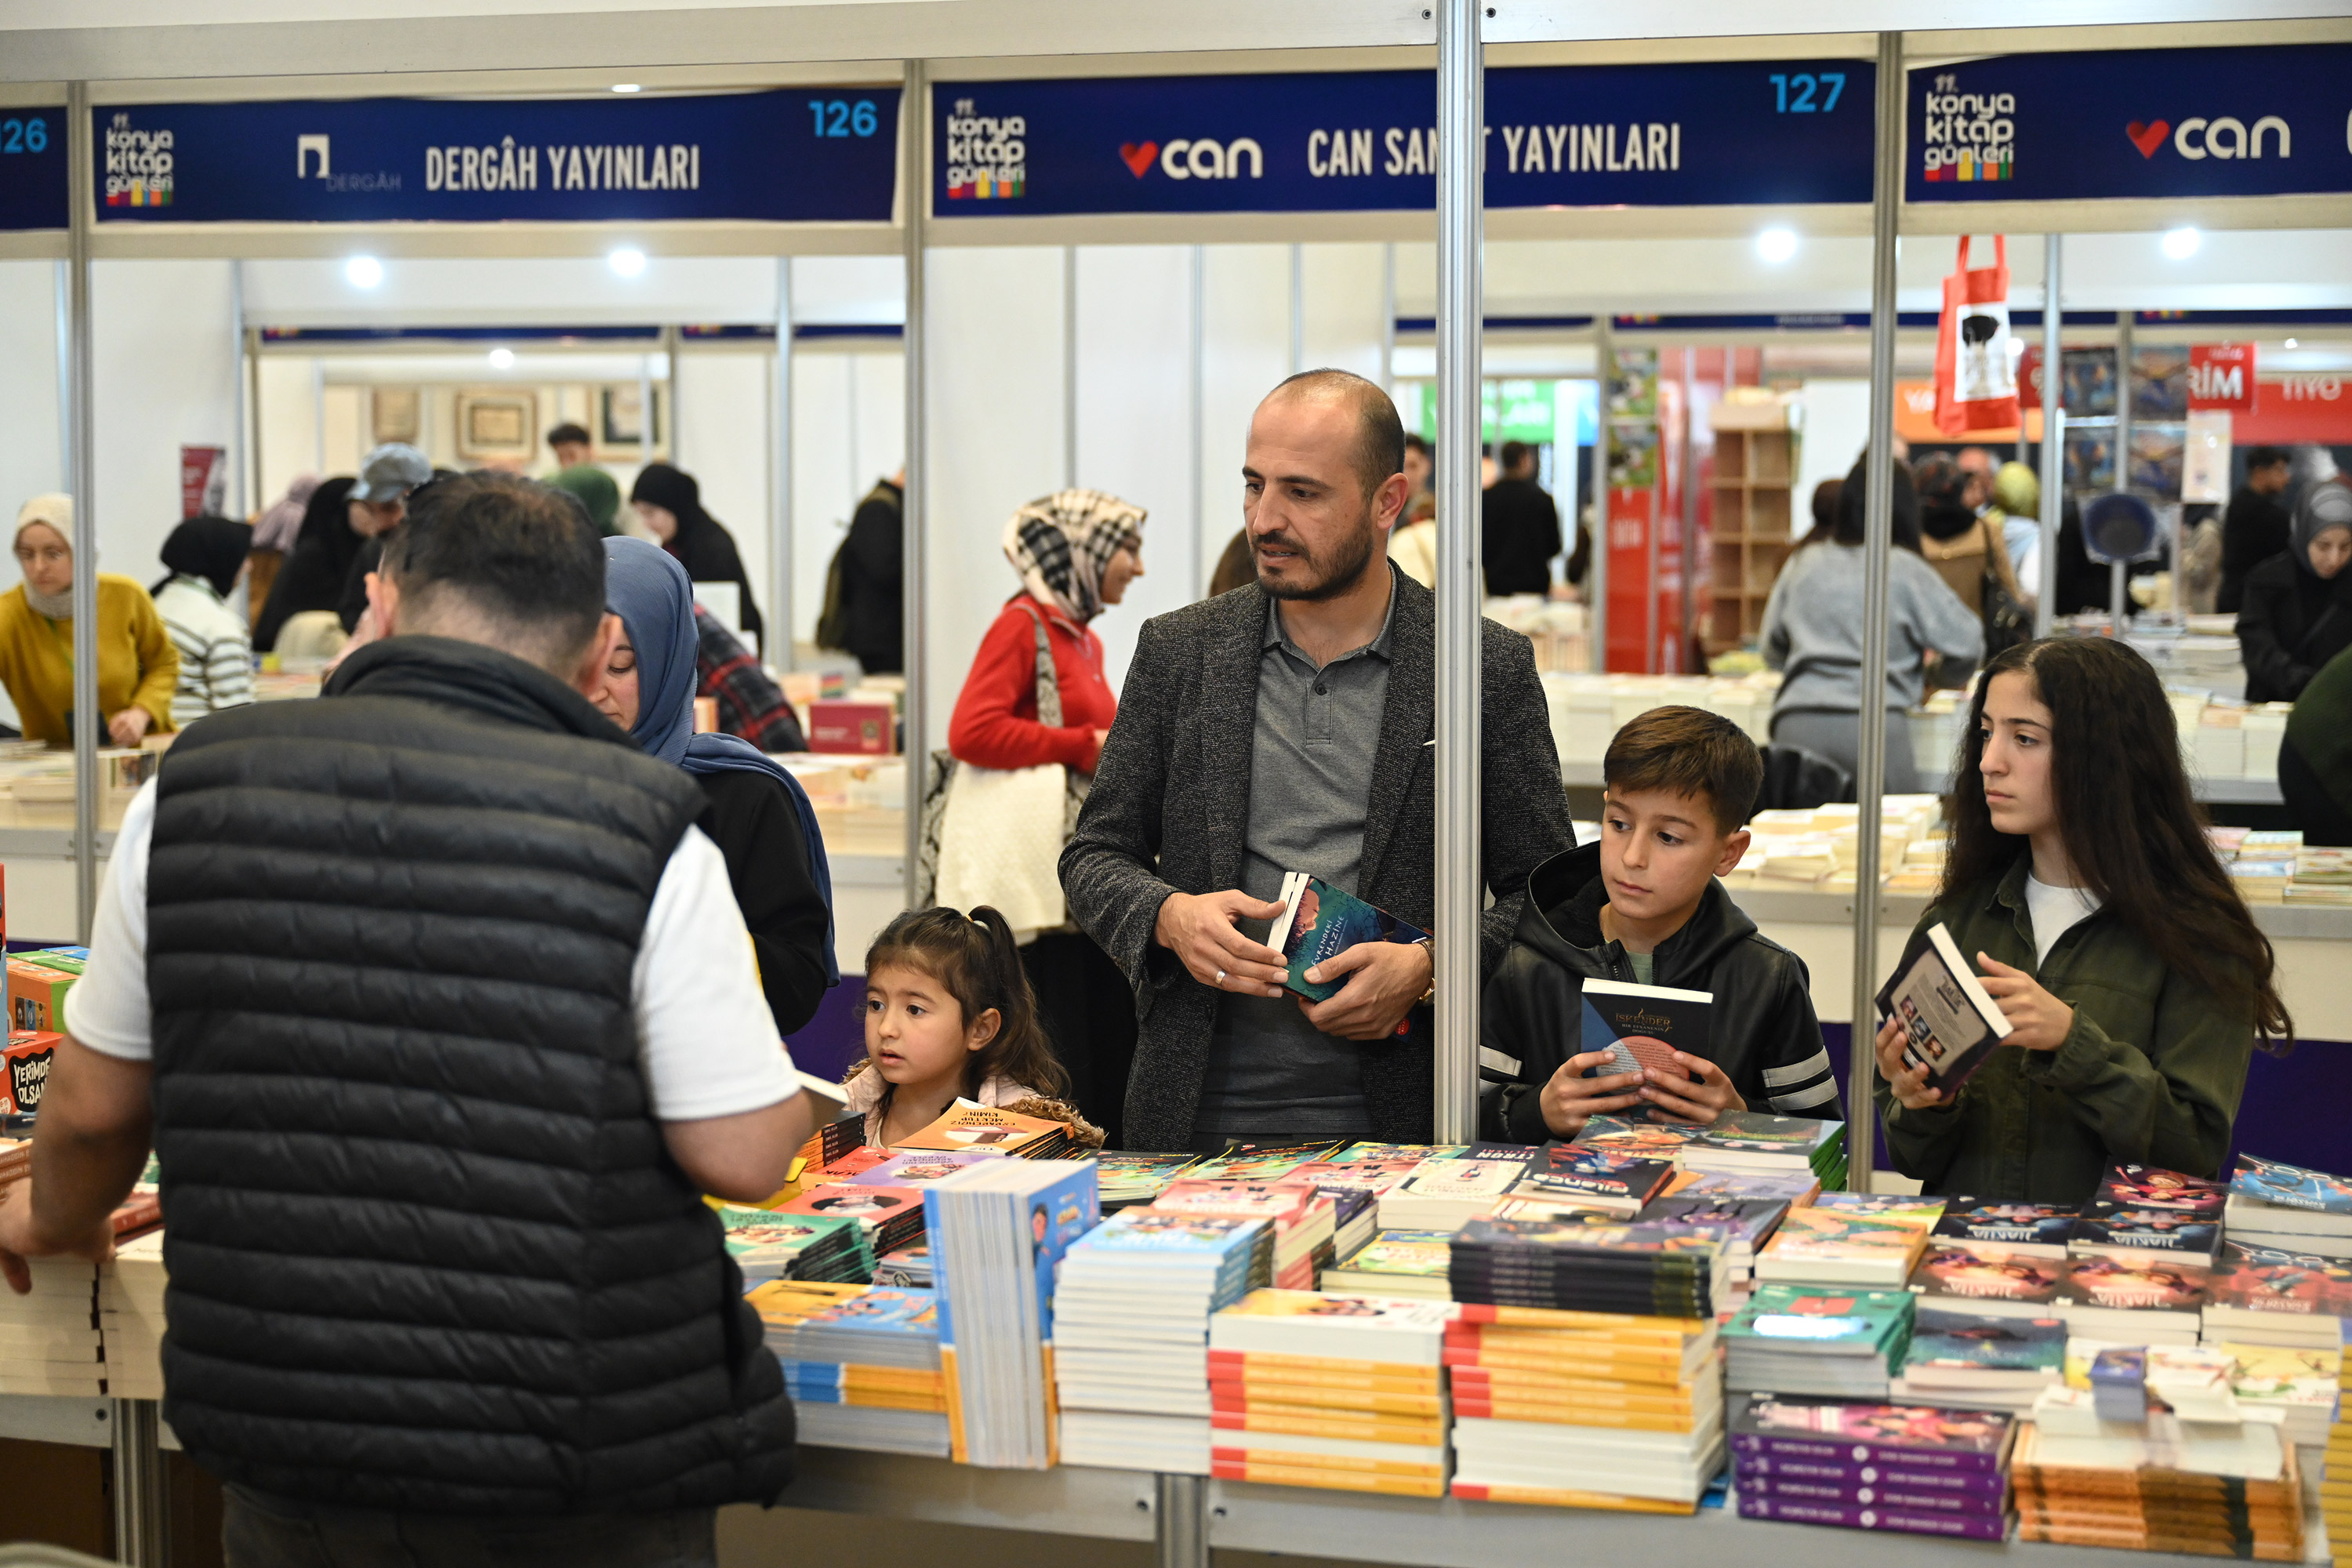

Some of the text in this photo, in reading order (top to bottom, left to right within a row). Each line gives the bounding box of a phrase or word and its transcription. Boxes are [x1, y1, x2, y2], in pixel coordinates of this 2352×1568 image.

[1769, 73, 1846, 113] 127
[1926, 91, 2015, 119] konya
[808, 100, 878, 137] 126
[947, 114, 1025, 140] konya
[1925, 114, 2014, 146] kitap
[0, 118, 47, 153] 26
[107, 127, 174, 151] konya
[947, 136, 1025, 164] kitap
[1308, 129, 1373, 177] CAN
[1502, 122, 1681, 173] YAYINLARI
[2174, 115, 2291, 160] can
[107, 147, 174, 174] kitap
[426, 135, 699, 191] DERGÂH YAYINLARI
[1160, 137, 1263, 180] can
[1924, 142, 2013, 170] günleri
[106, 172, 174, 198] günleri
[946, 162, 1025, 189] günleri
[1325, 916, 1345, 956] HAZİNE
[13, 1055, 51, 1089] YERİMDE
